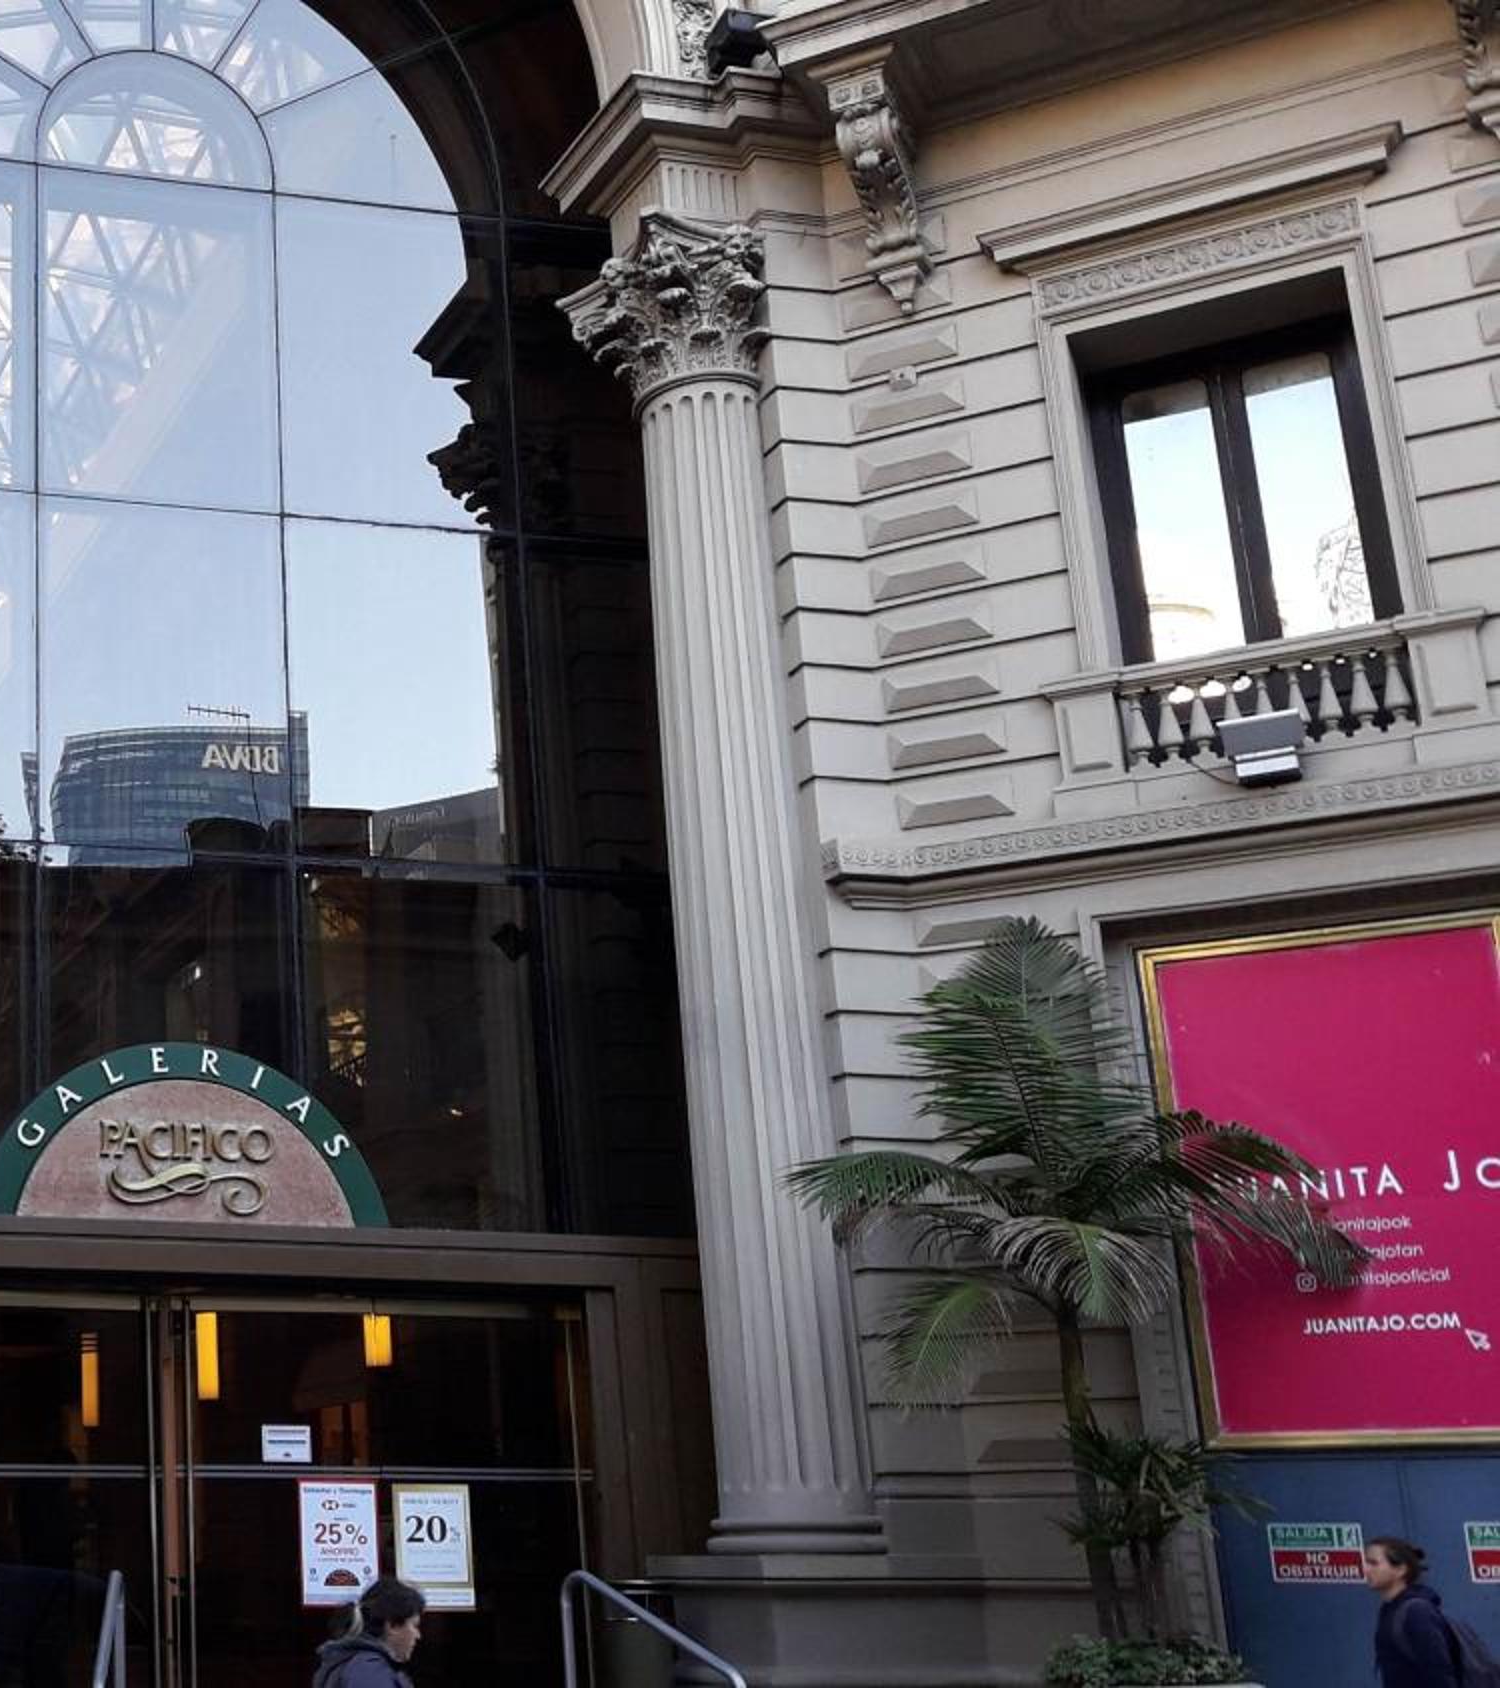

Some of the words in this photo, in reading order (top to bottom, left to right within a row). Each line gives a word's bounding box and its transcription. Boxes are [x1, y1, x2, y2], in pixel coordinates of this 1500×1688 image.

[17, 1047, 351, 1158] GALERIAS
[100, 1119, 277, 1163] PACIFICO
[1303, 1312, 1462, 1335] JUANITAJO.COM
[313, 1523, 368, 1545] 25%
[405, 1515, 447, 1543] 20
[1275, 1527, 1329, 1538] SALIDA
[1305, 1551, 1330, 1565] NO
[1279, 1565, 1360, 1578] OBSTRUIR
